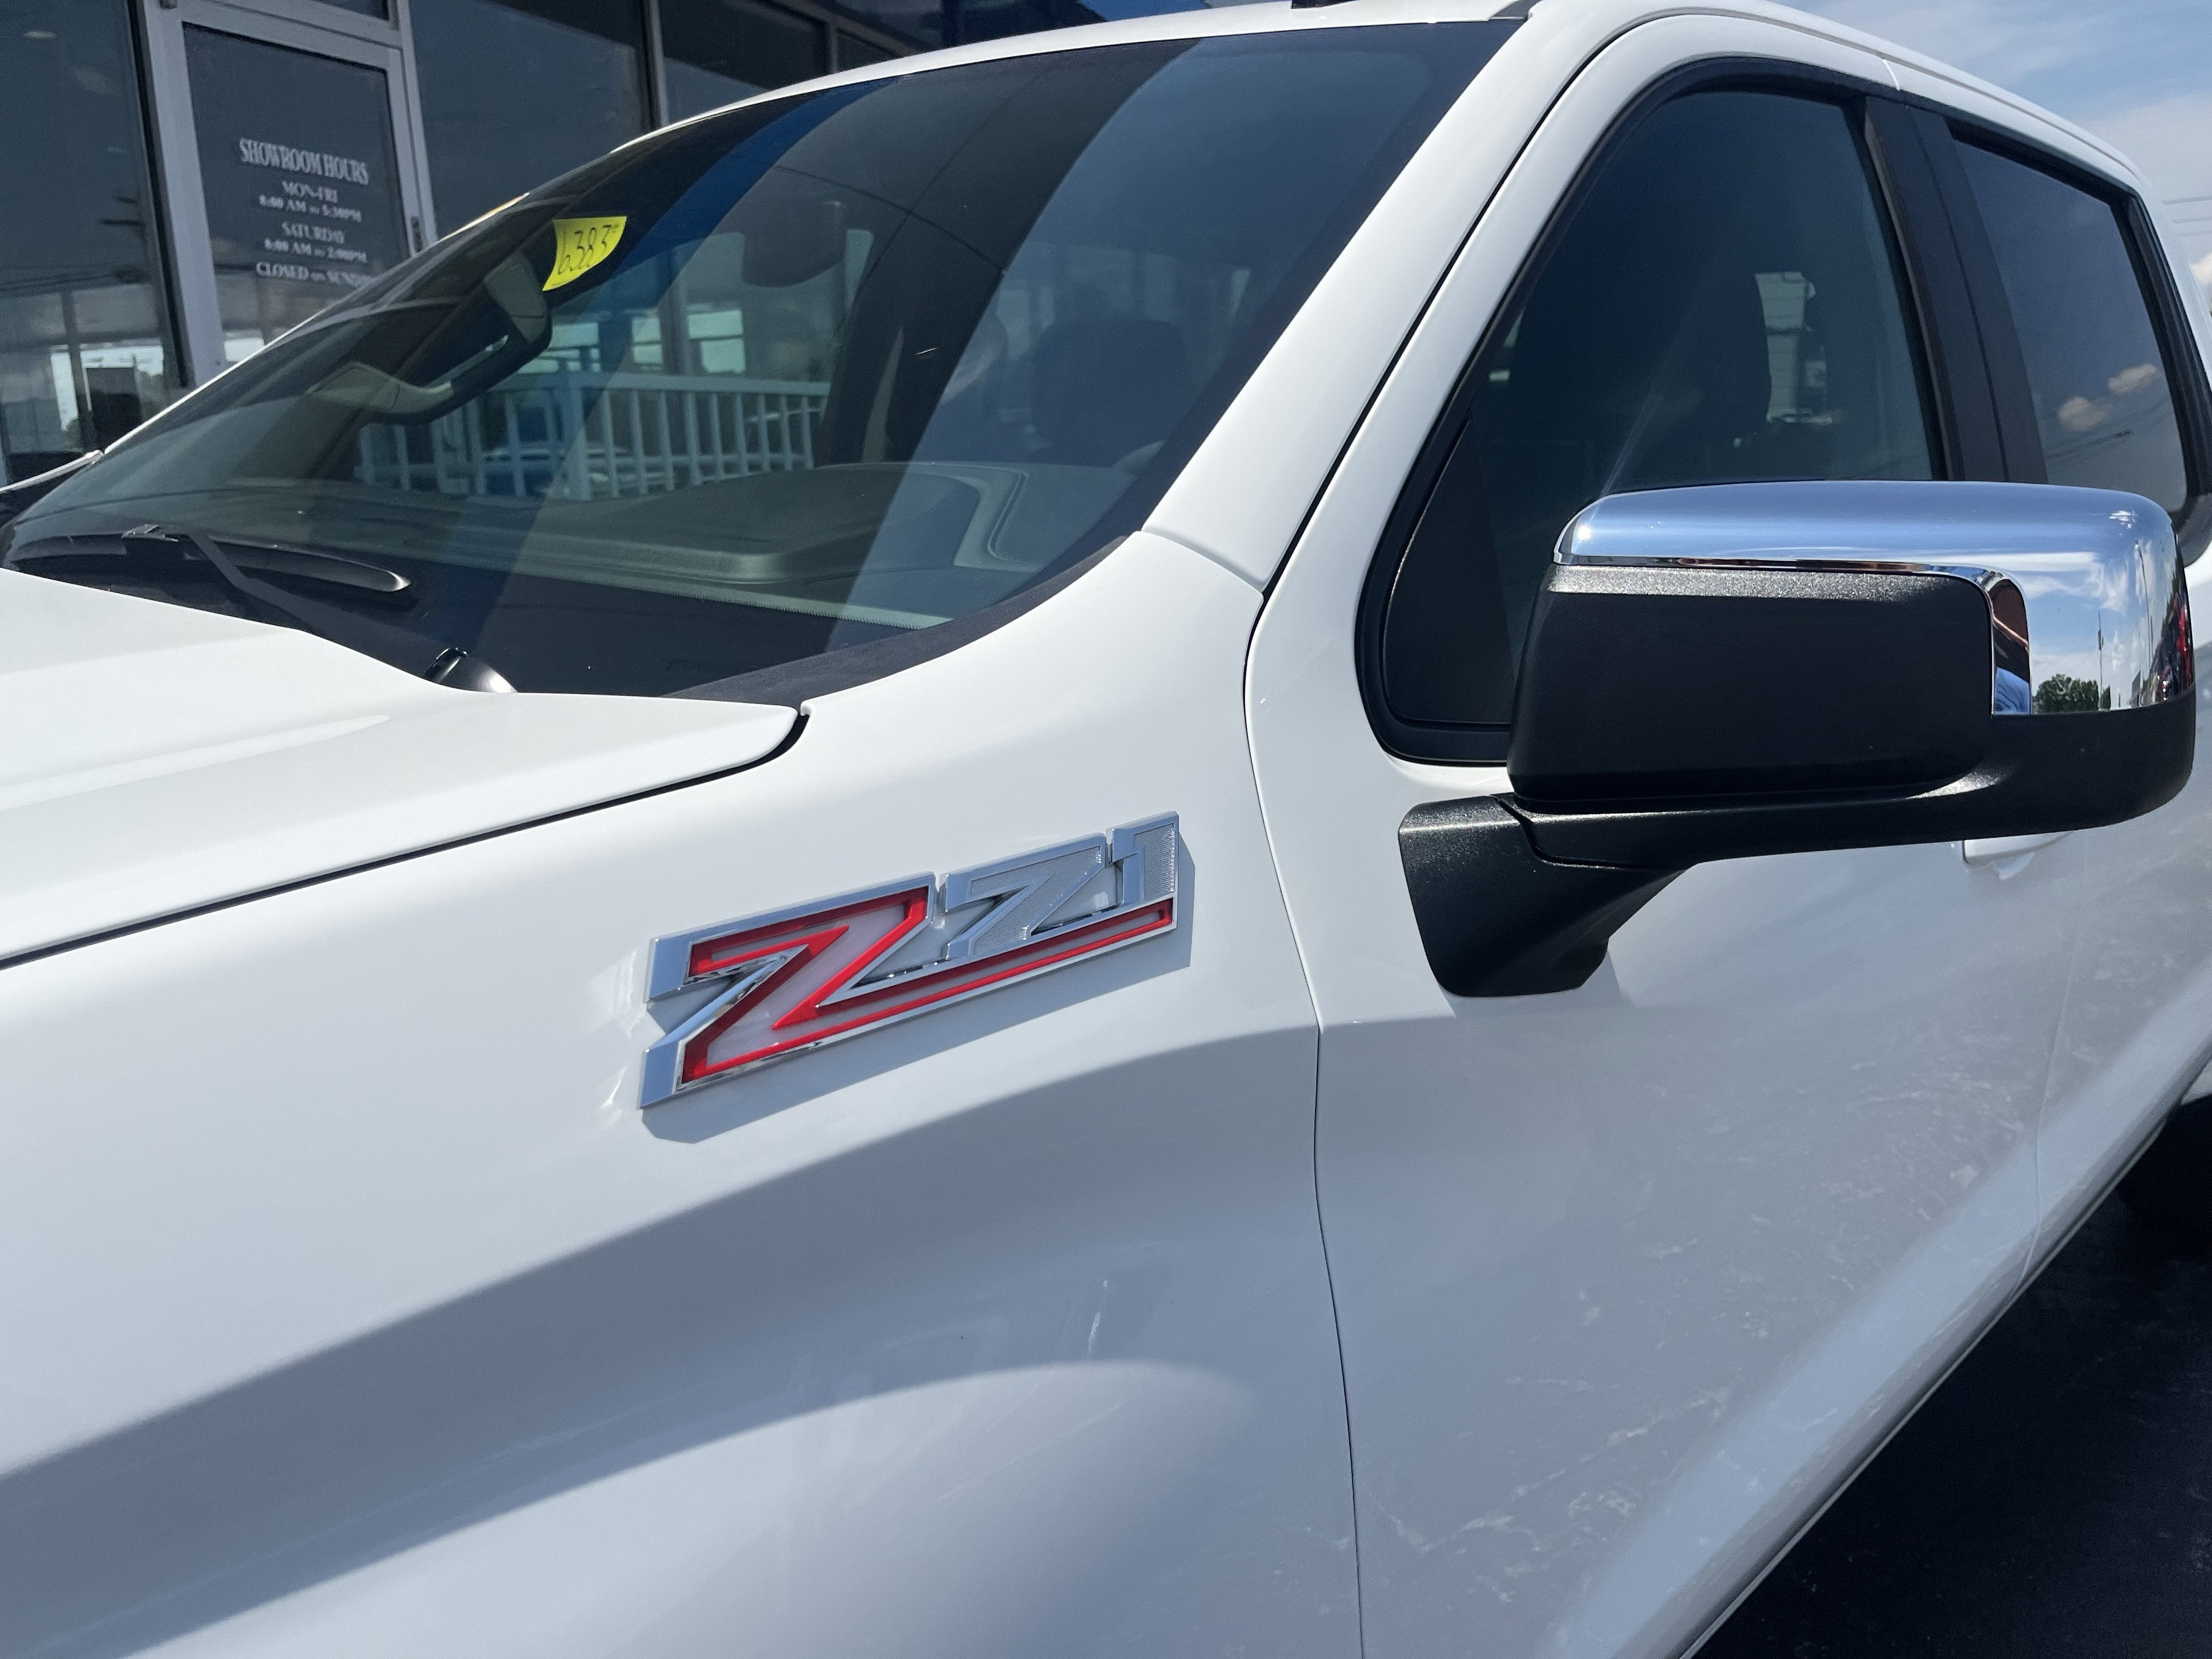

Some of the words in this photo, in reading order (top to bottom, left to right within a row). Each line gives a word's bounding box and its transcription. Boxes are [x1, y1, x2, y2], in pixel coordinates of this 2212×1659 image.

[239, 138, 323, 176] SHOWROOM
[323, 154, 369, 185] HOURS
[282, 180, 338, 204] MON-FRI
[285, 199, 307, 213] AM
[281, 221, 345, 245] SATURDAY
[291, 241, 312, 256] AM
[256, 261, 309, 281] CLOSED
[640, 811, 1180, 1109] Z71
